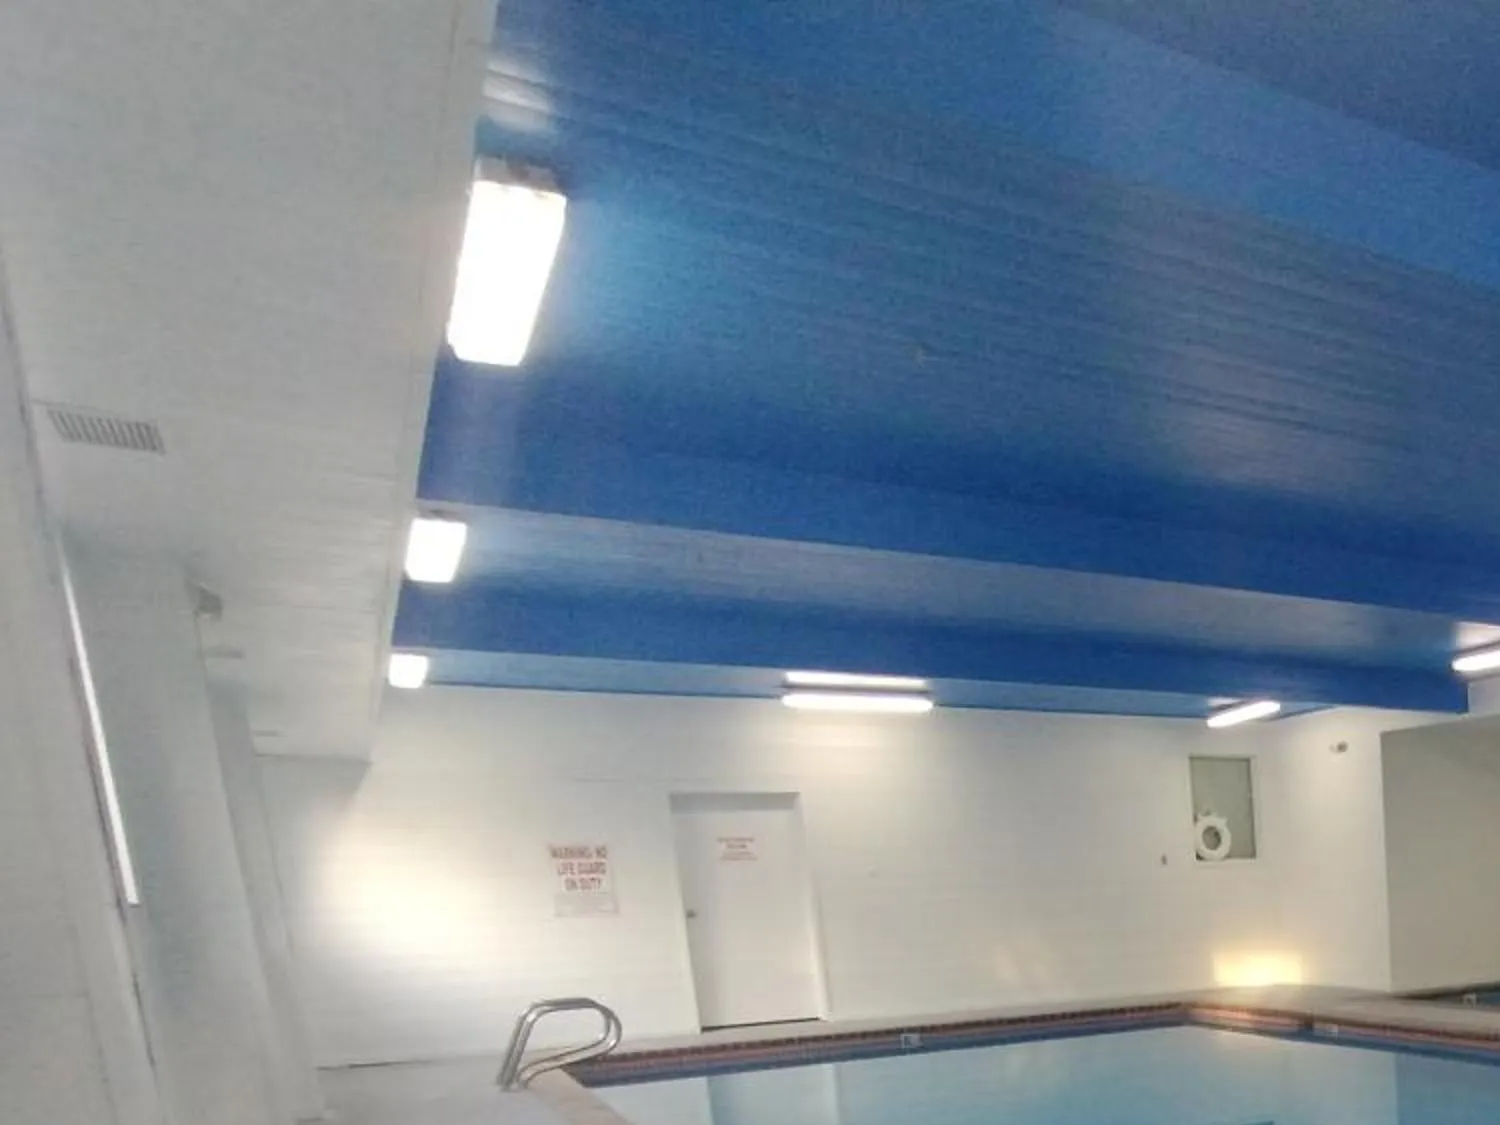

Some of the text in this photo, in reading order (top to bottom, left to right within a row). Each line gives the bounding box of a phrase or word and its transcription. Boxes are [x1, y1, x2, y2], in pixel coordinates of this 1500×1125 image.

[595, 845, 608, 859] NO
[557, 861, 576, 876] LIFE
[564, 878, 602, 891] ON DUTY
